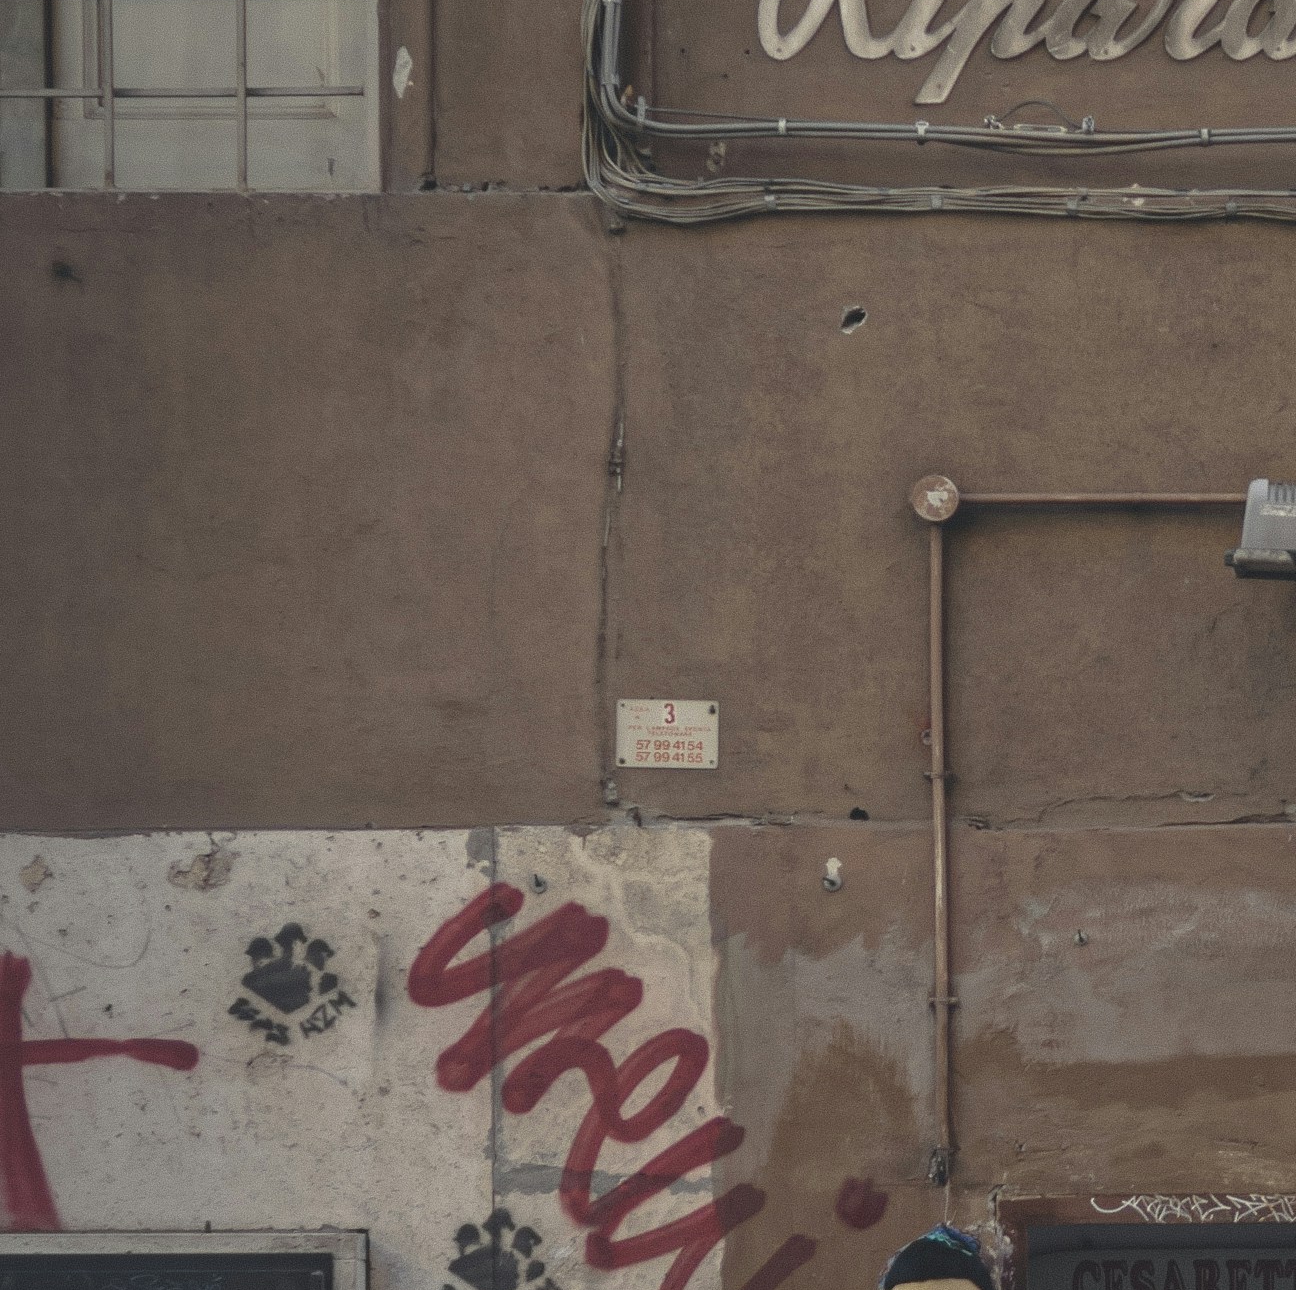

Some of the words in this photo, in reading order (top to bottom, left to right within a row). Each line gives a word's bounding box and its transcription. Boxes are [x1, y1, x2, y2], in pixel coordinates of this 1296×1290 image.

[664, 702, 676, 724] 3
[636, 739, 651, 750] 57
[653, 739, 671, 750] 99
[672, 740, 686, 750] 41
[635, 751, 651, 762] 57
[672, 752, 685, 762] 41
